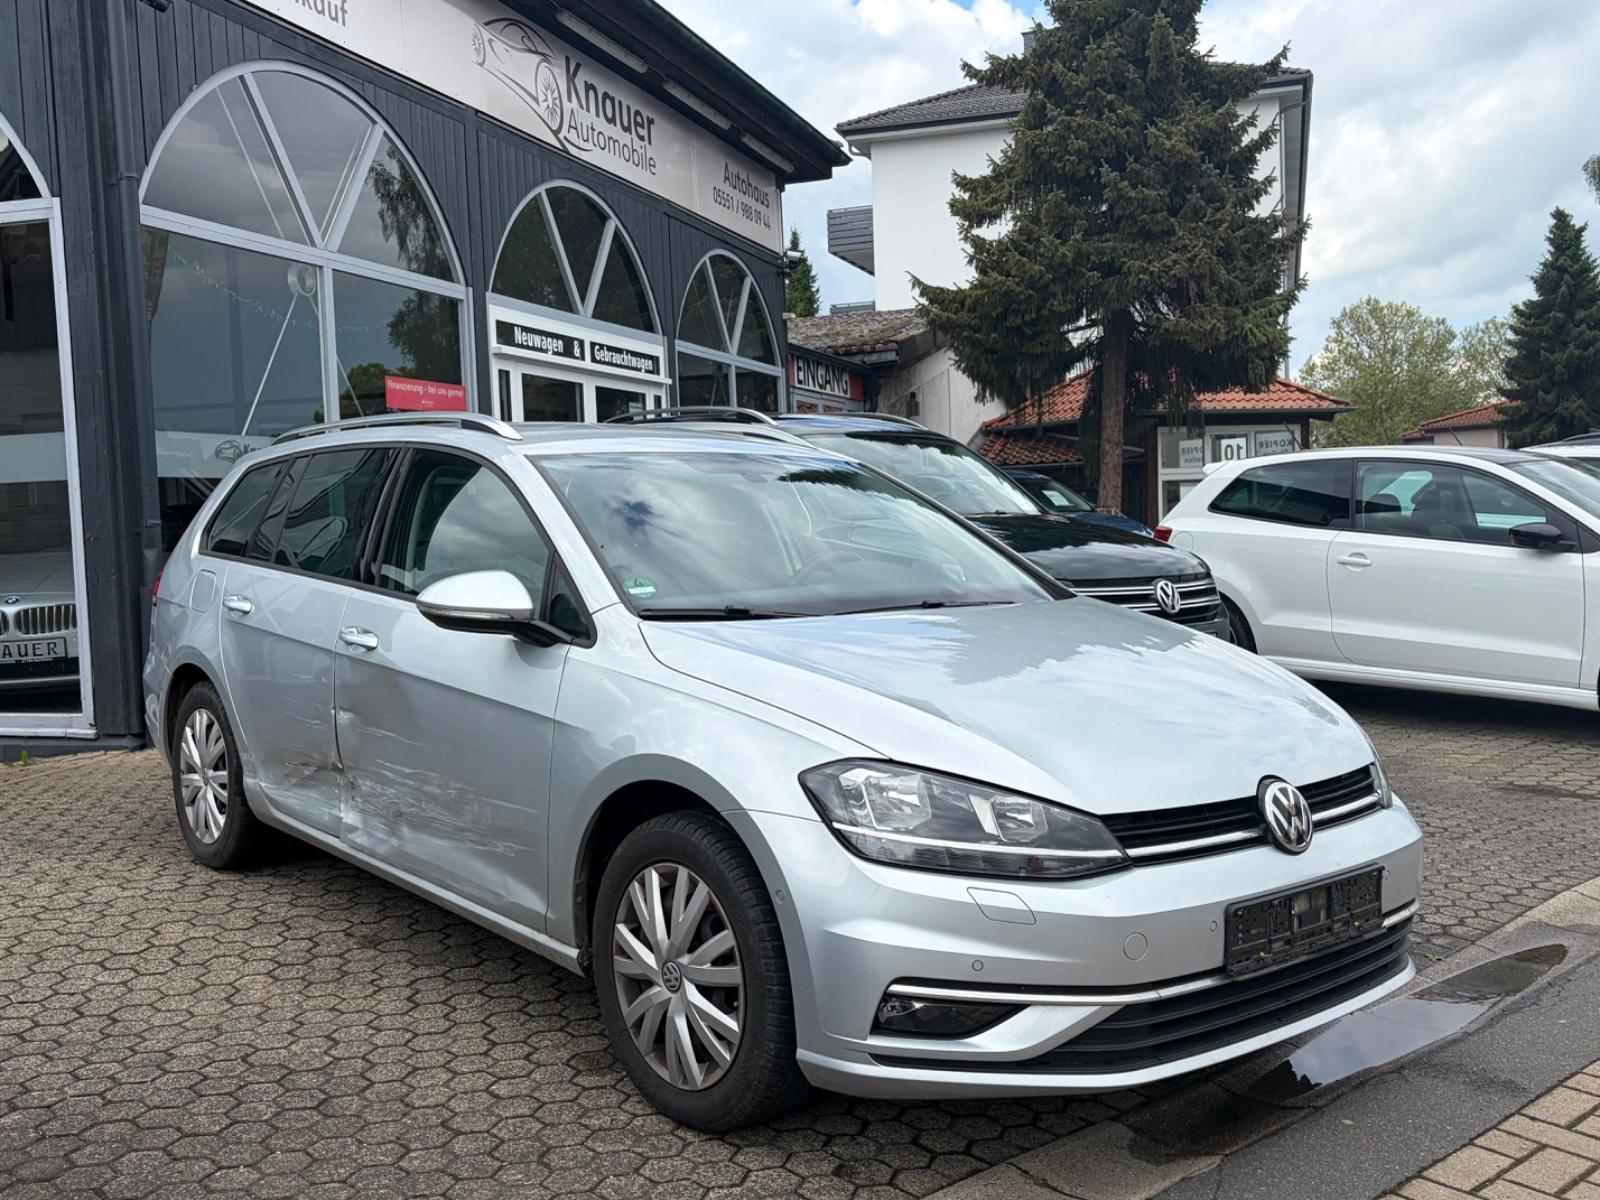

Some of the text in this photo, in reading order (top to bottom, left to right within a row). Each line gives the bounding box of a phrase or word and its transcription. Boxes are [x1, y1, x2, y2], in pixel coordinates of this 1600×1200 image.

[565, 54, 655, 146] Knauer
[567, 107, 657, 176] Automobile
[713, 185, 735, 212] 05551
[723, 160, 770, 209] Autohaus
[513, 325, 653, 373] Neuwagen & Gebrauchtwagen
[796, 356, 849, 396] EINGANG
[2, 641, 58, 659] AUER
